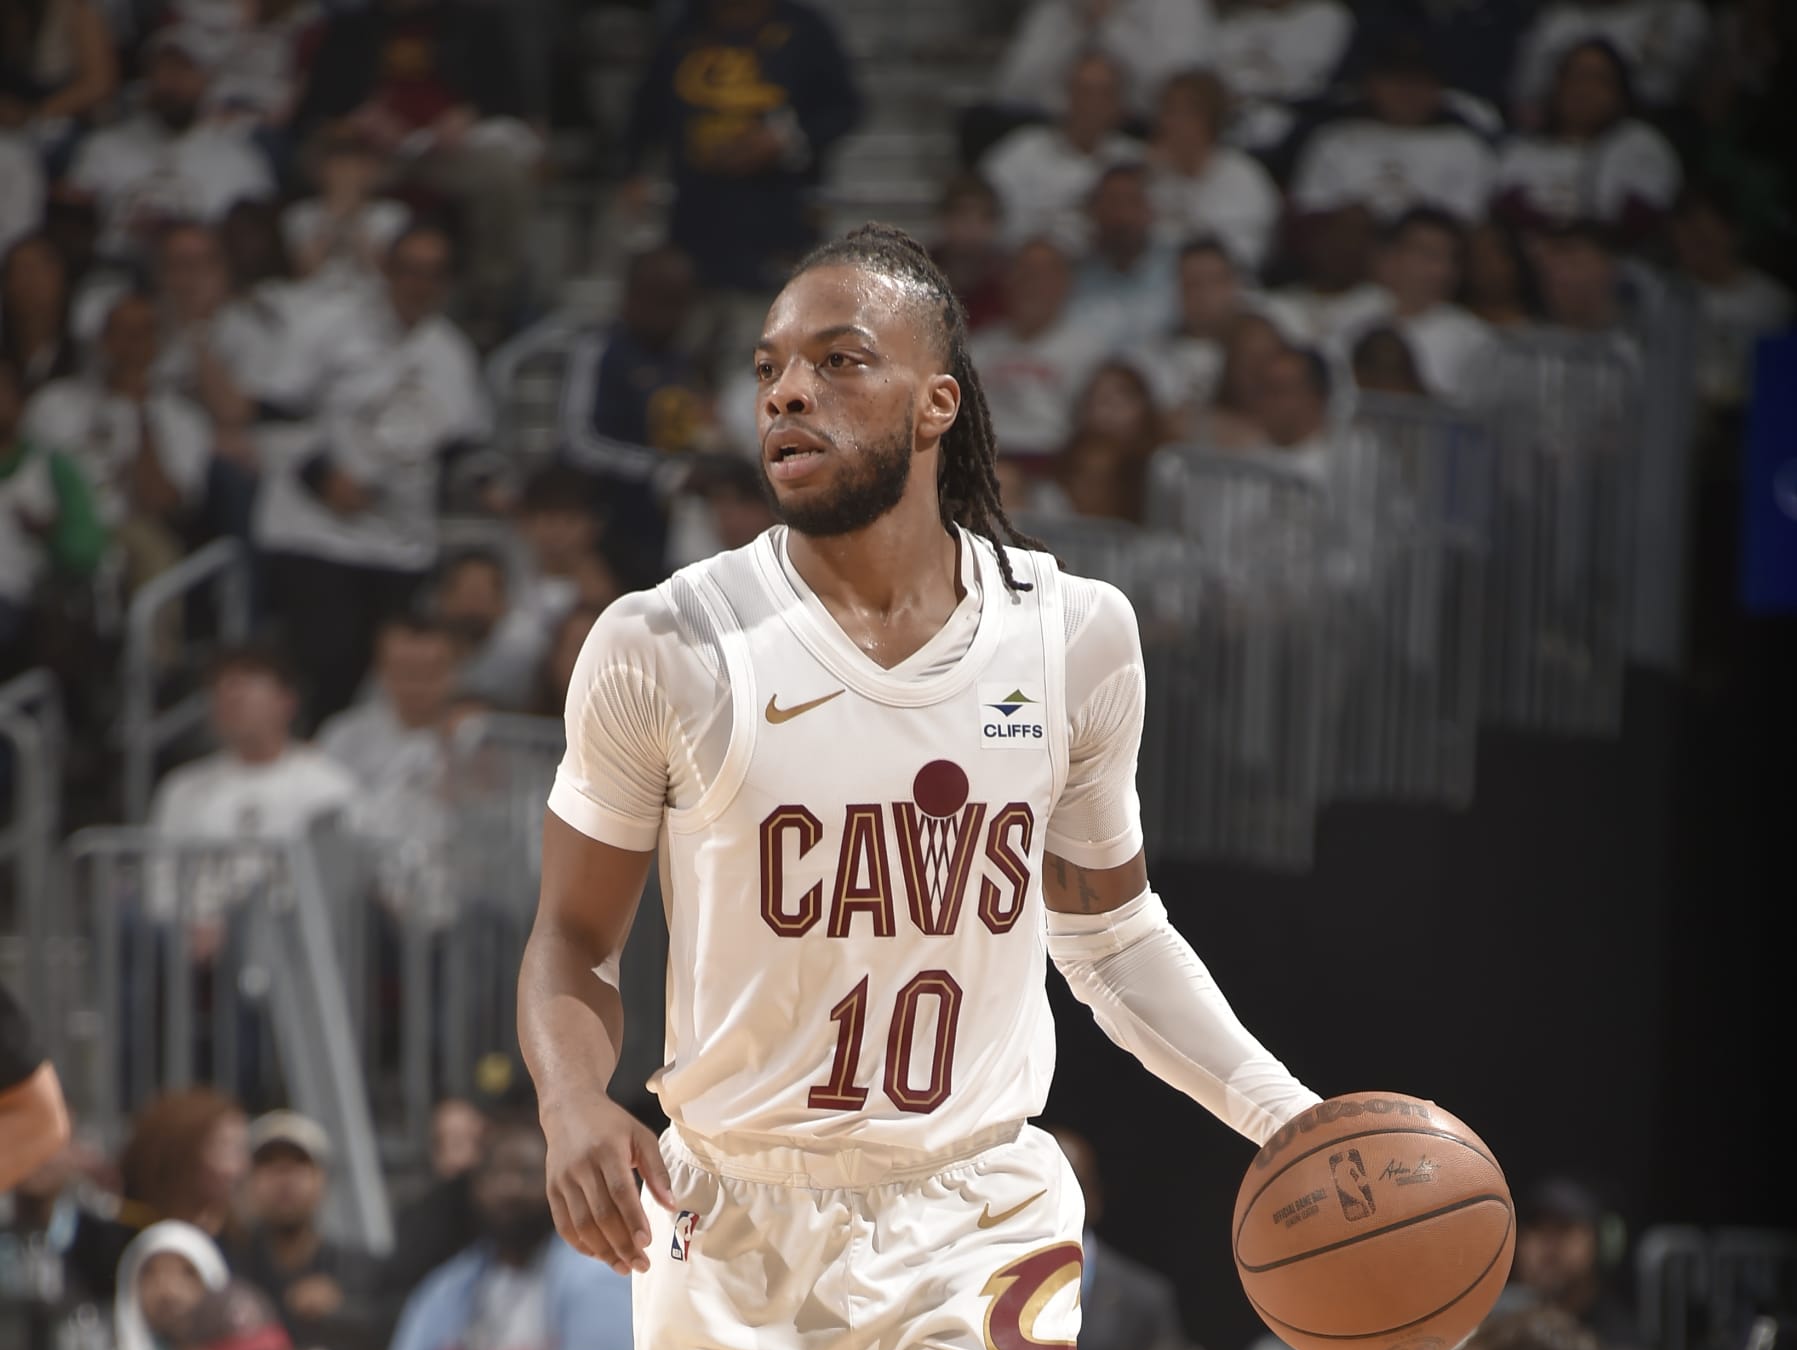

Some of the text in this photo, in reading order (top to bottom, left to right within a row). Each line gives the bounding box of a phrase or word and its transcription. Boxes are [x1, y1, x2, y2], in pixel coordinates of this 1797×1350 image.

[983, 723, 1043, 739] CLIFFS
[759, 801, 1035, 939] CAVS
[807, 969, 964, 1115] 10
